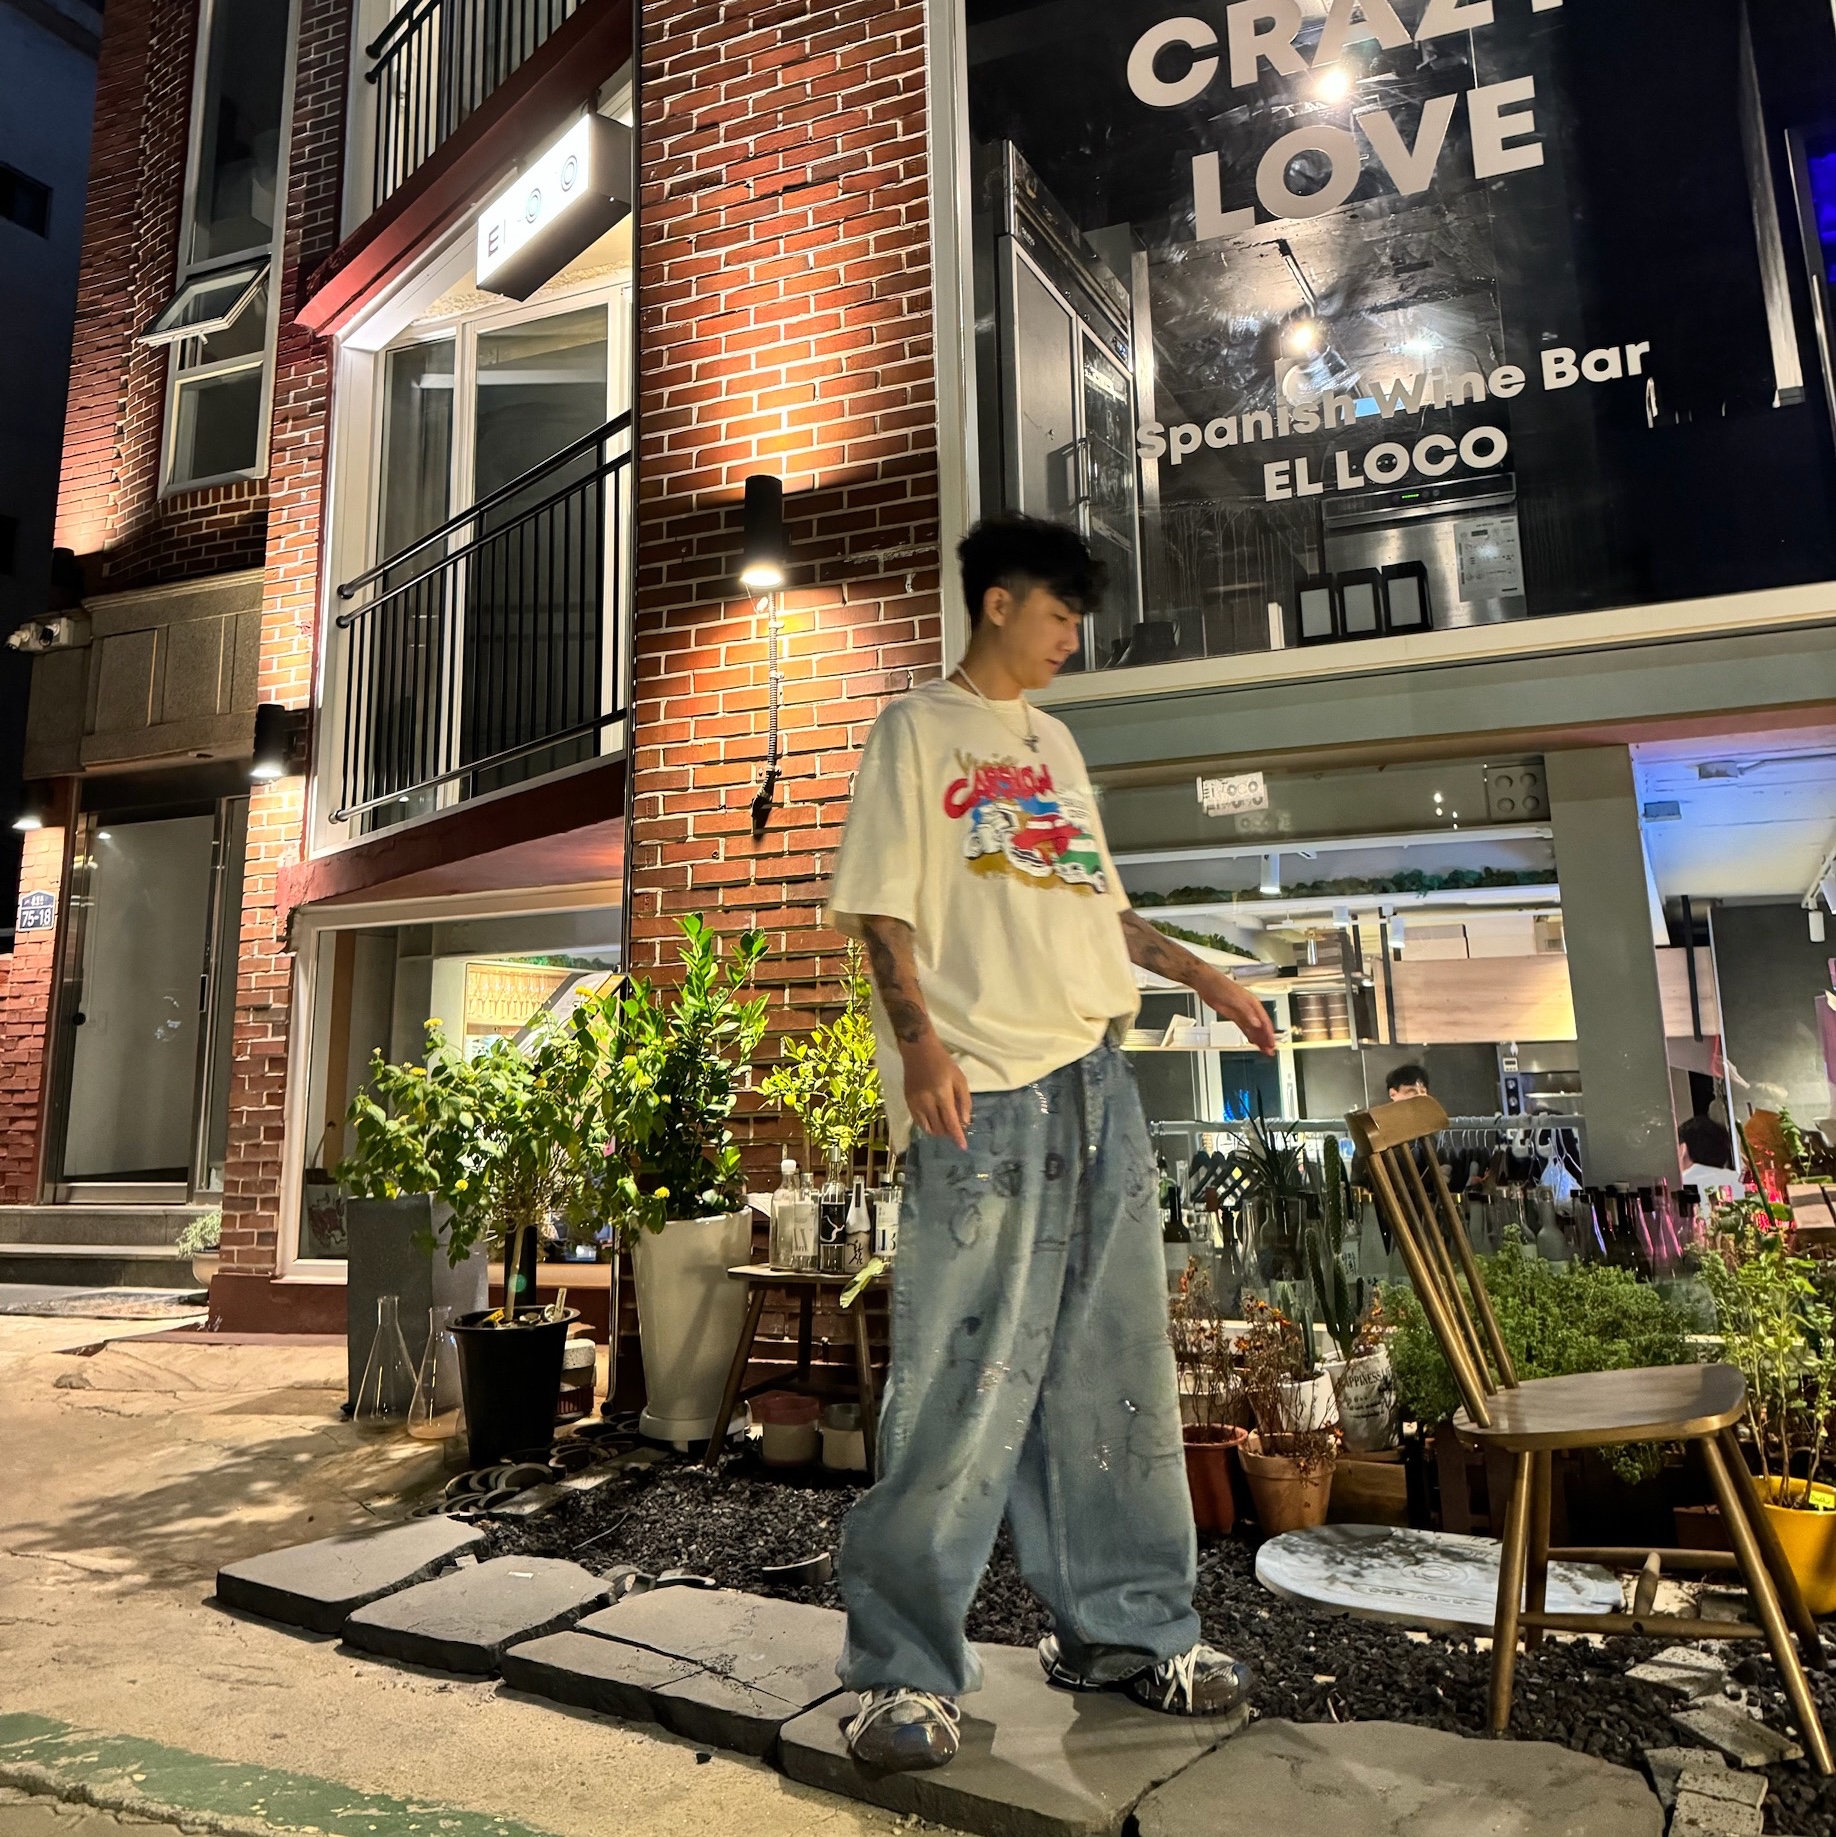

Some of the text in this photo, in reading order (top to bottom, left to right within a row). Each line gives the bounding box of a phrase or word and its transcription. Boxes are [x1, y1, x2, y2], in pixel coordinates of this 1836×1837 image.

[1127, 0, 1563, 107] CRA
[517, 154, 579, 225] OO
[1192, 75, 1545, 241] LOVE
[1136, 340, 1651, 466] Spanish Wine Bar
[1263, 425, 1508, 502] EL LOCO
[22, 908, 52, 928] 75-18
[1345, 1369, 1382, 1388] PPINESS
